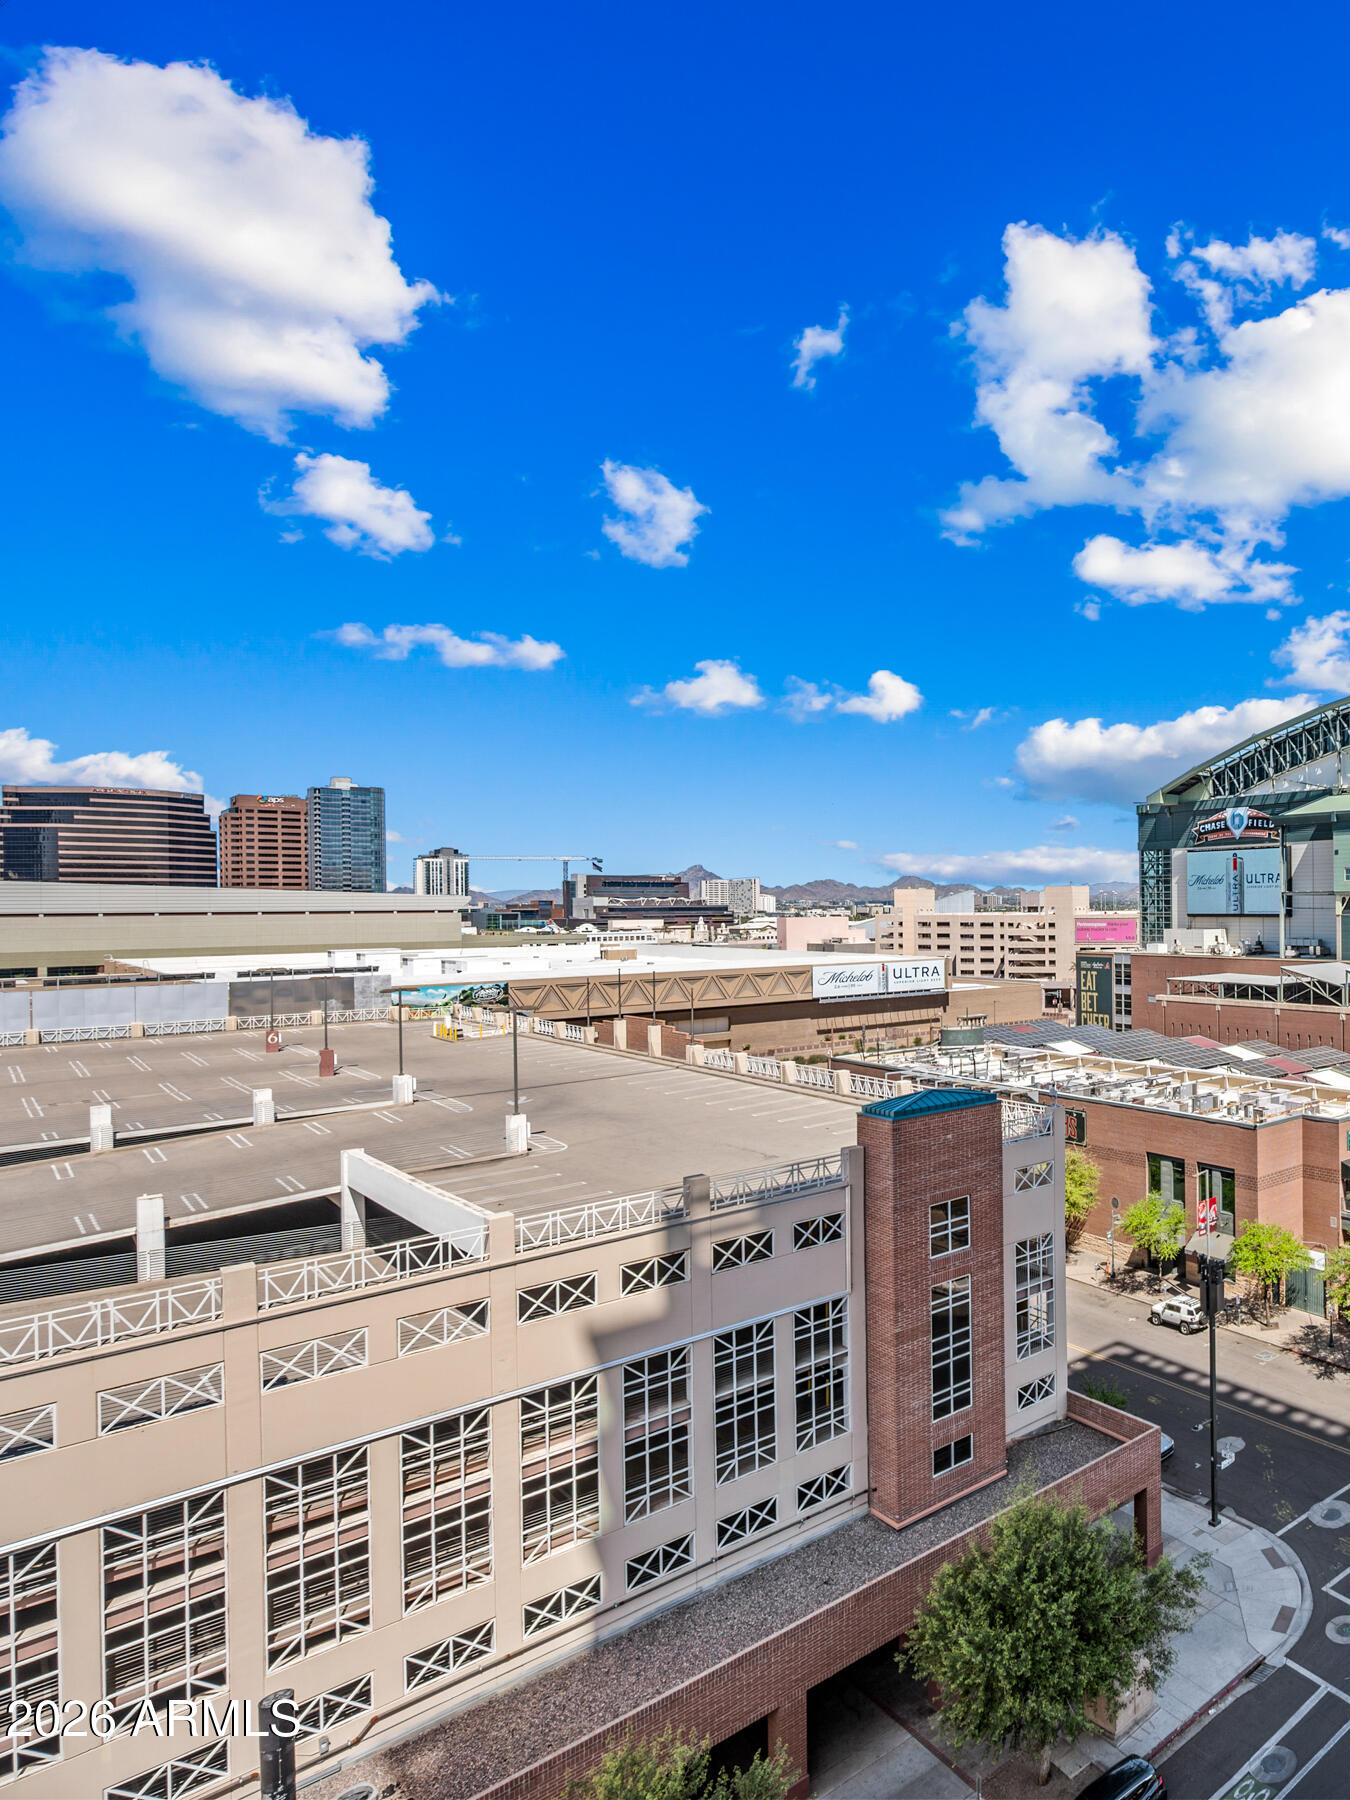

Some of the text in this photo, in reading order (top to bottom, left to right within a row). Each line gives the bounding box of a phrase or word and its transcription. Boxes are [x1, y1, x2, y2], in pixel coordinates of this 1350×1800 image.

[1199, 819, 1275, 833] CHASE FIELD
[1188, 873, 1280, 887] Michelob ULTRA
[817, 966, 940, 986] Michelob ULTRA
[1080, 970, 1097, 991] EAT
[1081, 992, 1098, 1012] BET
[1081, 1012, 1110, 1029] CHEER
[267, 1033, 278, 1044] 6
